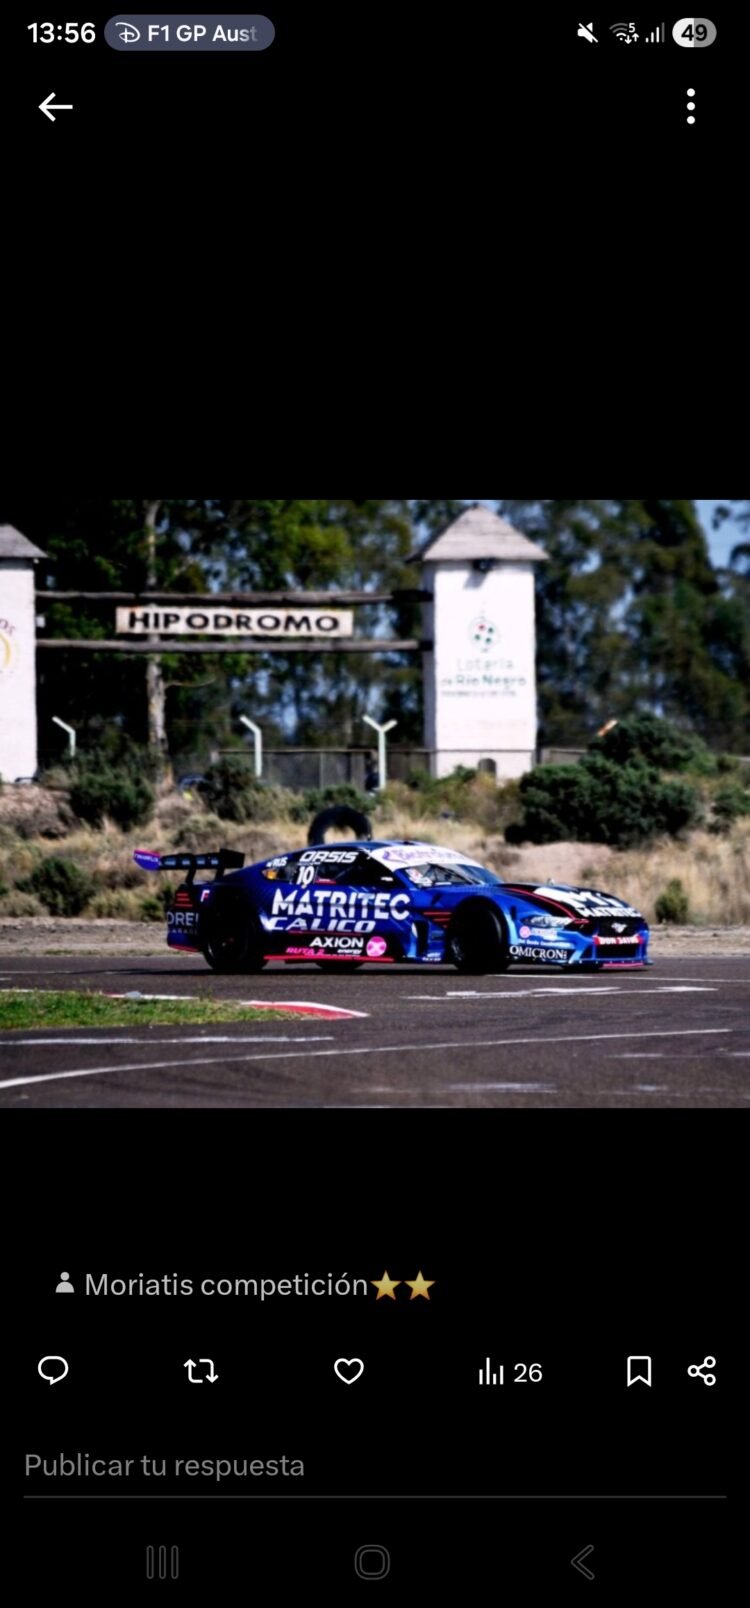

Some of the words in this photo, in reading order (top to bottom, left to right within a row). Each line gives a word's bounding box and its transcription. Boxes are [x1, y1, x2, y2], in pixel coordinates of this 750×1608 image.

[128, 611, 340, 632] HIPODROMO
[299, 850, 359, 864] OASIS
[296, 865, 315, 885] 10
[271, 888, 411, 921] MATRITEC
[271, 916, 376, 934] CALICO
[309, 937, 364, 948] AXION
[509, 945, 563, 960] OMICRON
